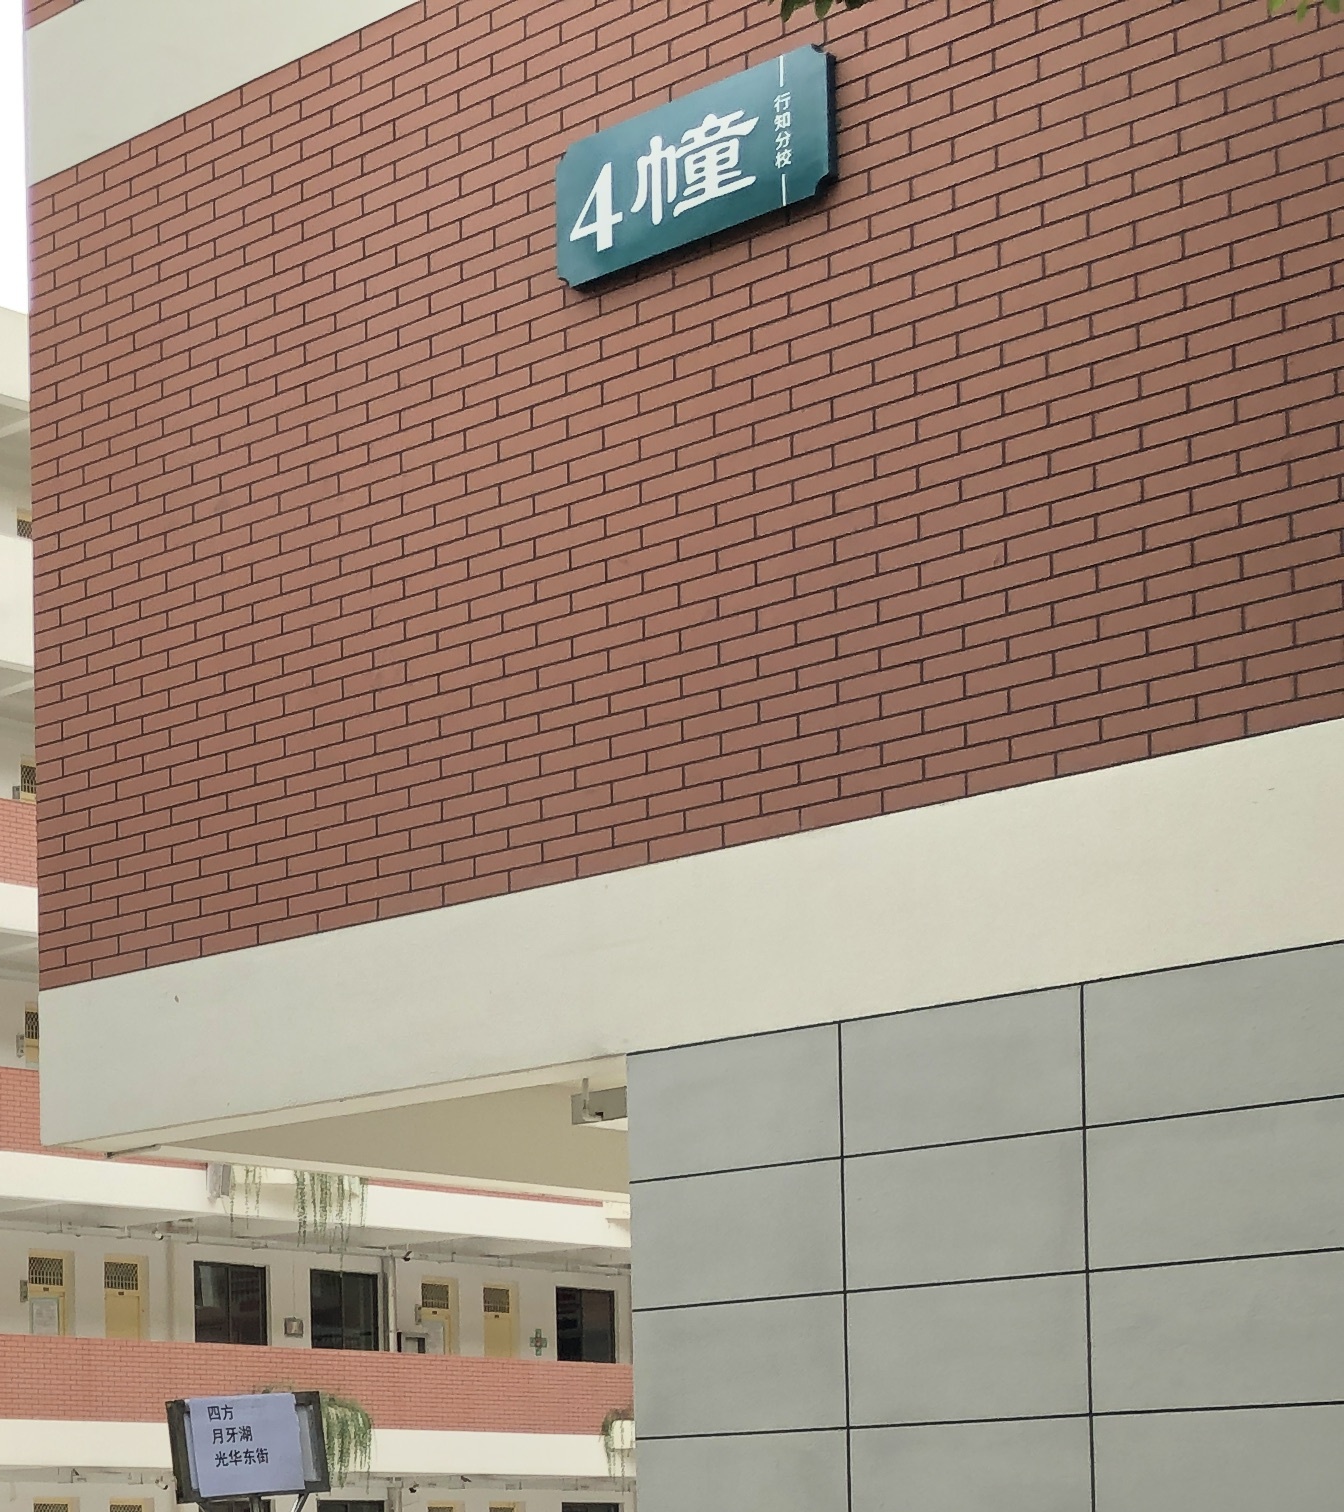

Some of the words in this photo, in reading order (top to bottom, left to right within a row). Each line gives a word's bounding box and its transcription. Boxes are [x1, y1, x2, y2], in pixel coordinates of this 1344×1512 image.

[773, 92, 792, 169] 行知分校
[569, 109, 760, 253] 4幢
[207, 1404, 234, 1422] 四方
[212, 1425, 253, 1445] 月牙湖
[215, 1448, 269, 1468] 光华东街
